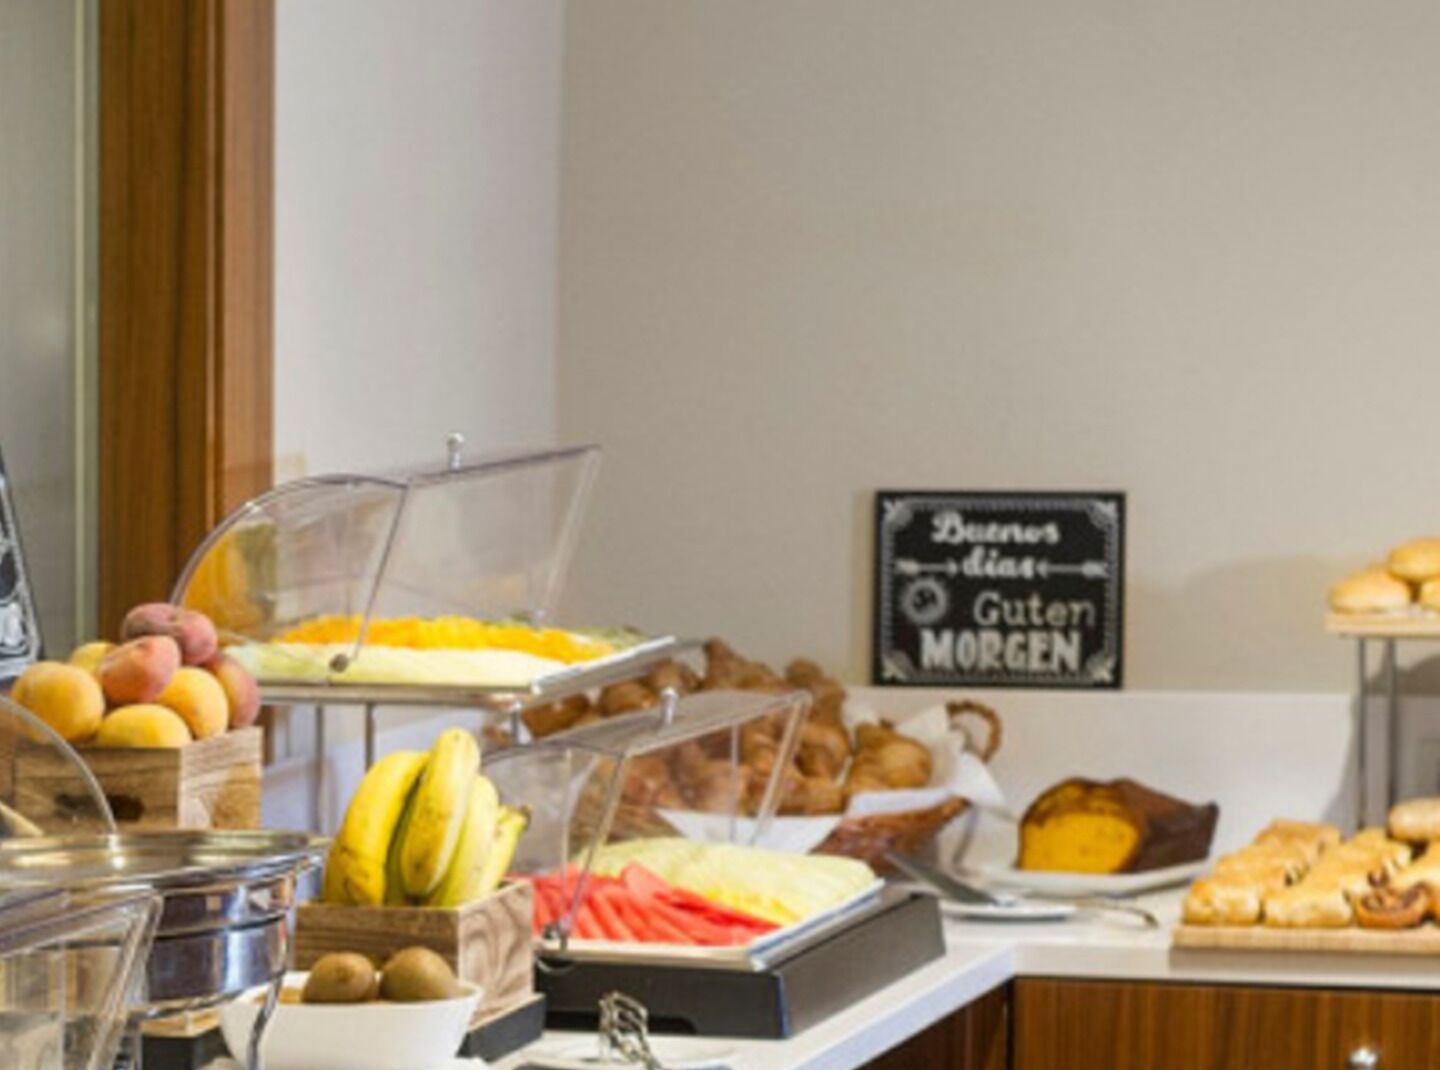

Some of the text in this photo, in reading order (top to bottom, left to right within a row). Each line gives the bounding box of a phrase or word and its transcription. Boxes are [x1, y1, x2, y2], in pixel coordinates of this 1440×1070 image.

[930, 509, 1060, 545] Buenos
[973, 591, 1096, 627] Guten
[920, 628, 1082, 672] MORGEN
